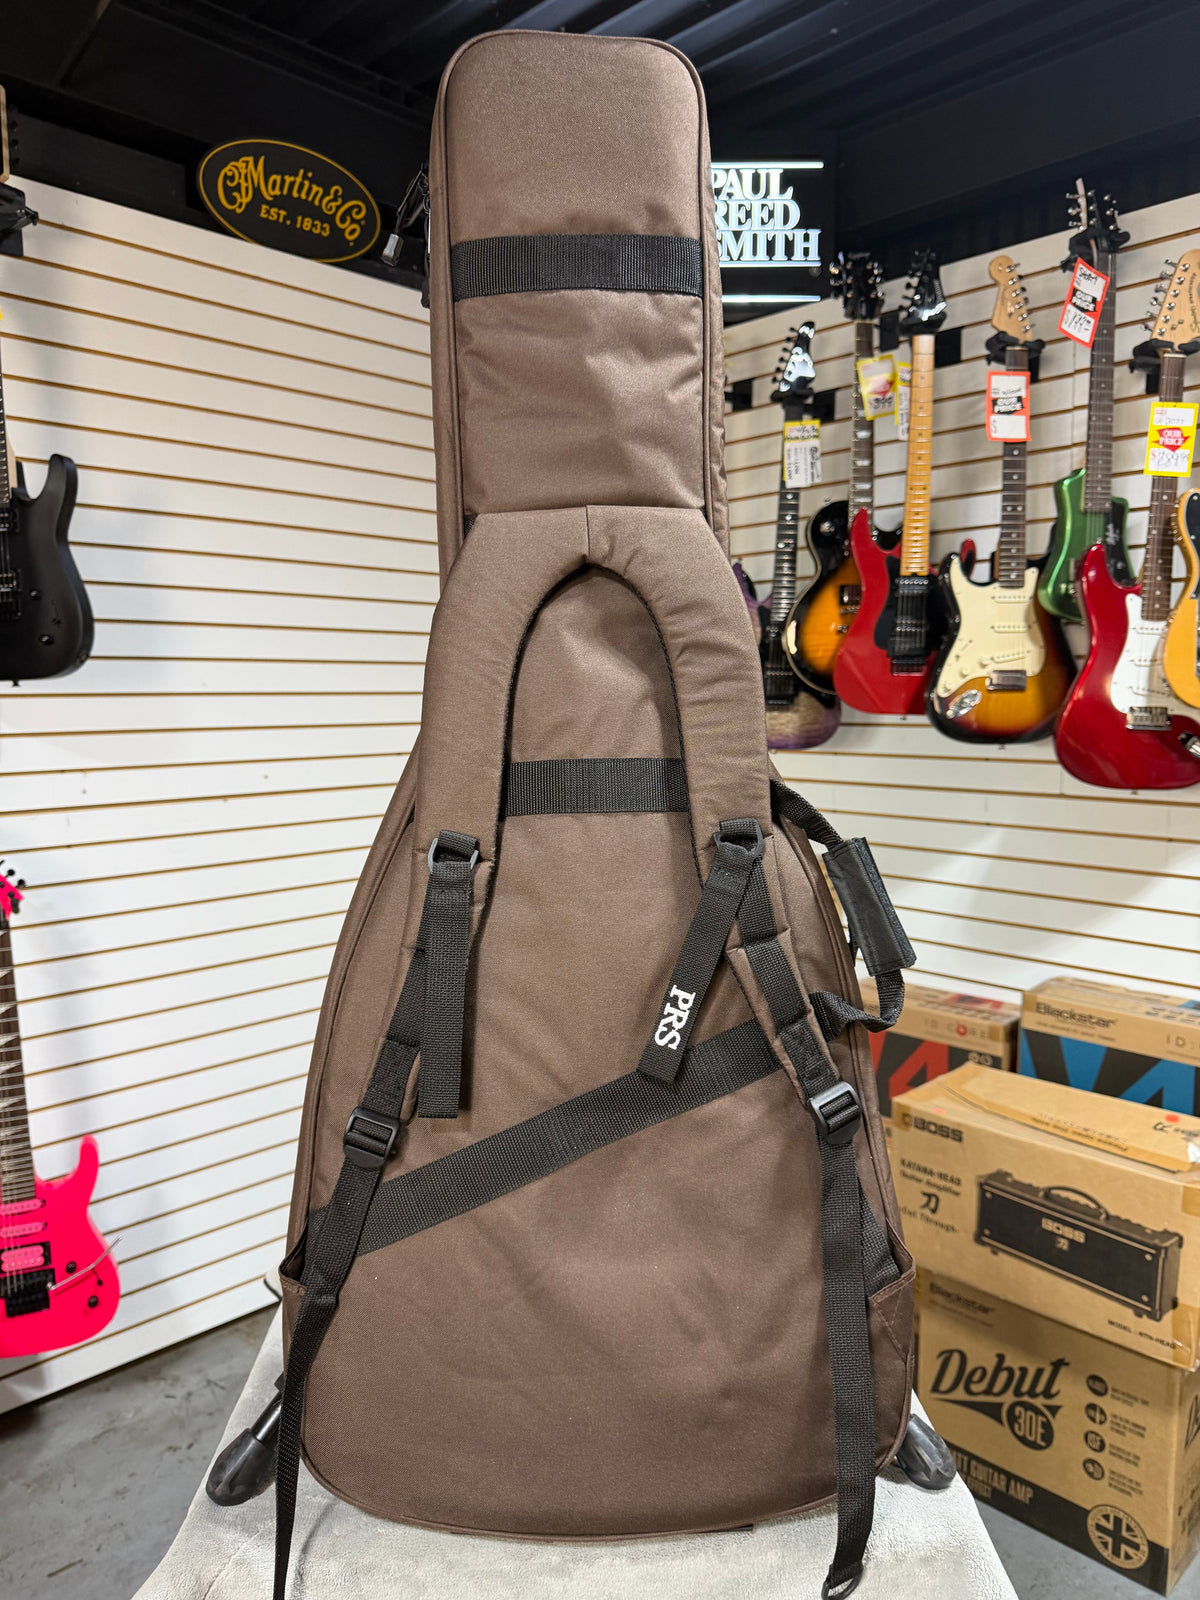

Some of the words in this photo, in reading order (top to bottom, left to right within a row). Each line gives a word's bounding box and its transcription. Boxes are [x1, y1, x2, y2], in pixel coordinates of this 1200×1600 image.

[711, 167, 794, 200] PAUL
[259, 203, 291, 226] EST.
[296, 215, 331, 238] 1833
[714, 199, 801, 231] REED
[655, 985, 697, 1051] PRS
[1035, 1001, 1118, 1028] Blackstar
[913, 1116, 964, 1143] BOSS
[1041, 1217, 1086, 1244] BOSS
[930, 1348, 1070, 1401] Debut
[1012, 1406, 1047, 1449] 30E
[1008, 1479, 1034, 1505] AMP
